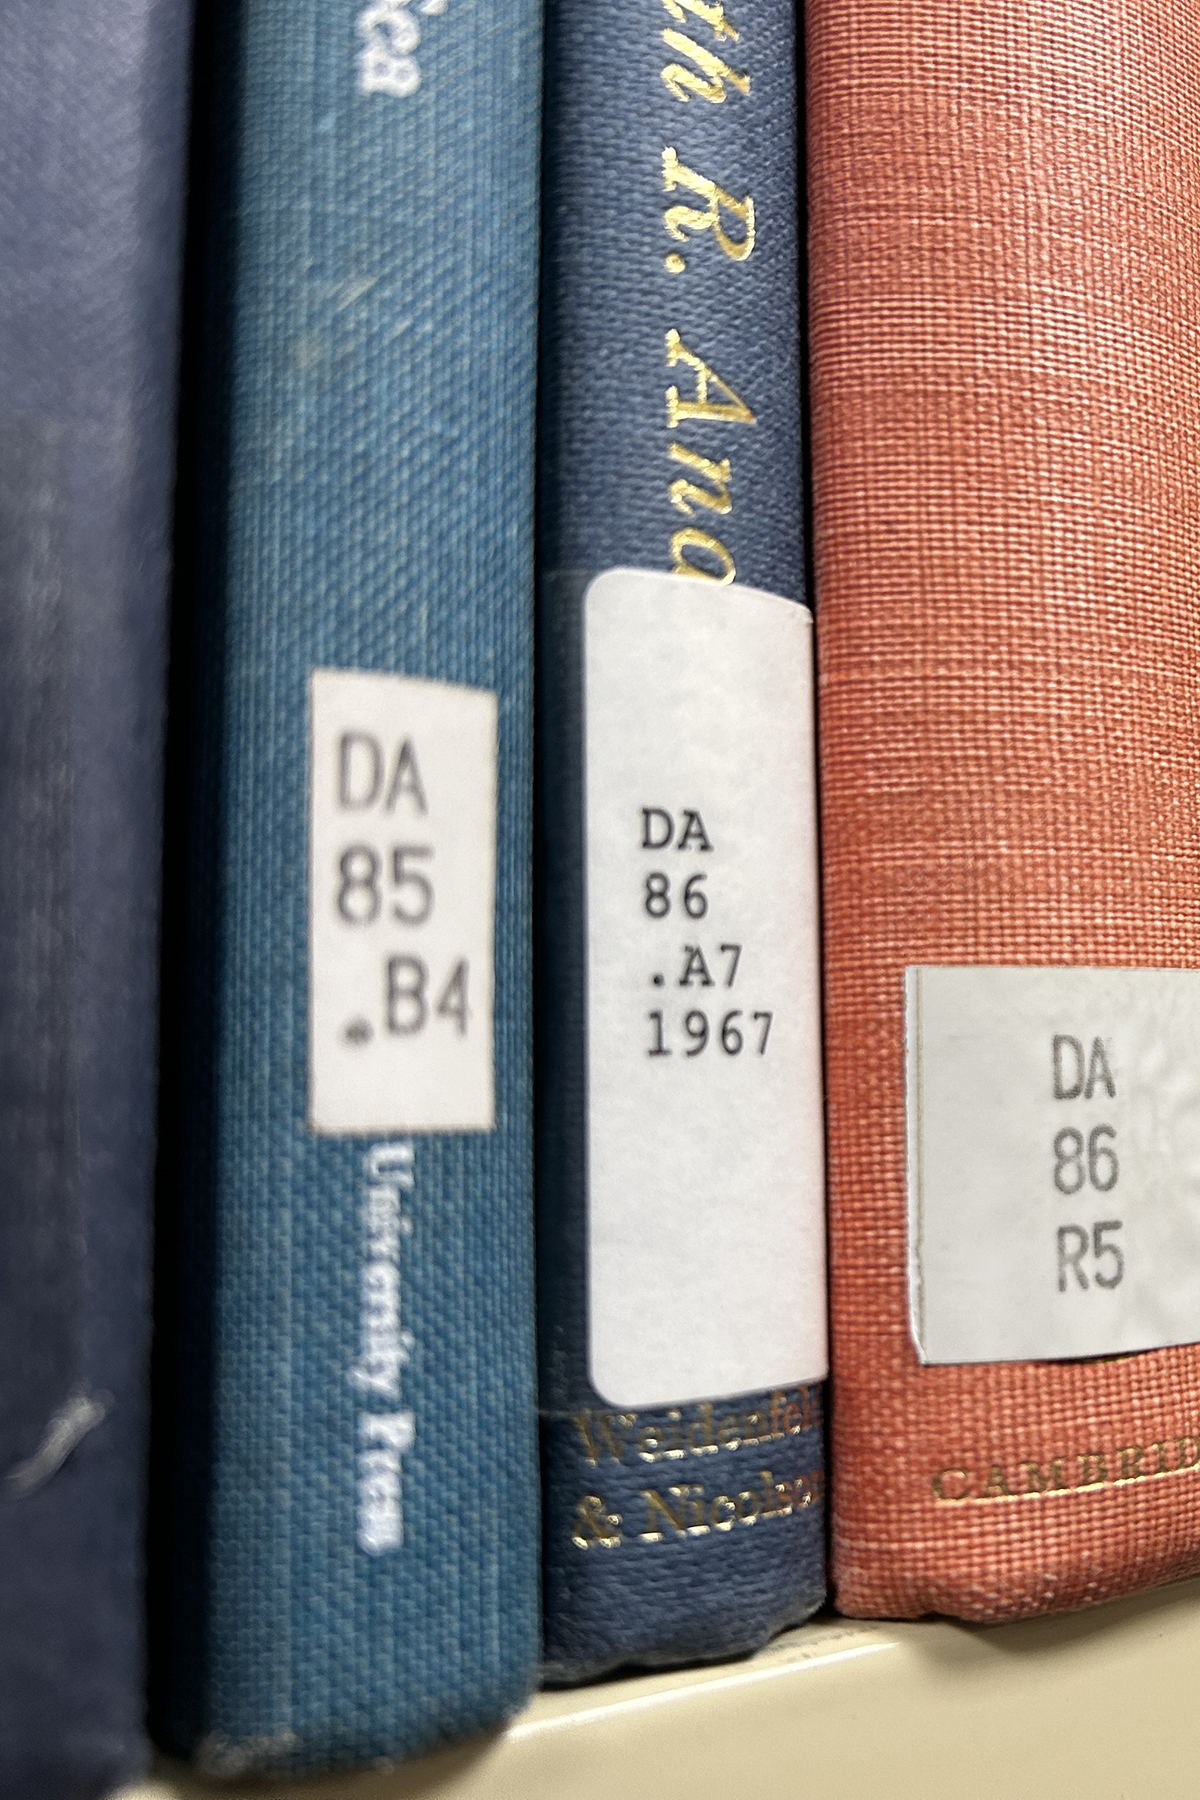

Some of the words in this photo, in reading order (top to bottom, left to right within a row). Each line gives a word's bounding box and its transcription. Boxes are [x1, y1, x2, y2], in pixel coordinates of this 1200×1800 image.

[661, 147, 756, 275] R.
[338, 731, 429, 817] DA
[640, 807, 715, 853] DA
[336, 843, 436, 928] 85
[644, 871, 709, 920] 86
[340, 952, 472, 1049] .B4
[650, 943, 744, 989] .A7
[645, 1009, 775, 1058] 1967
[1052, 1033, 1118, 1101] DA
[1053, 1123, 1120, 1196] 86
[1057, 1219, 1126, 1293] R5
[571, 1495, 623, 1550] &
